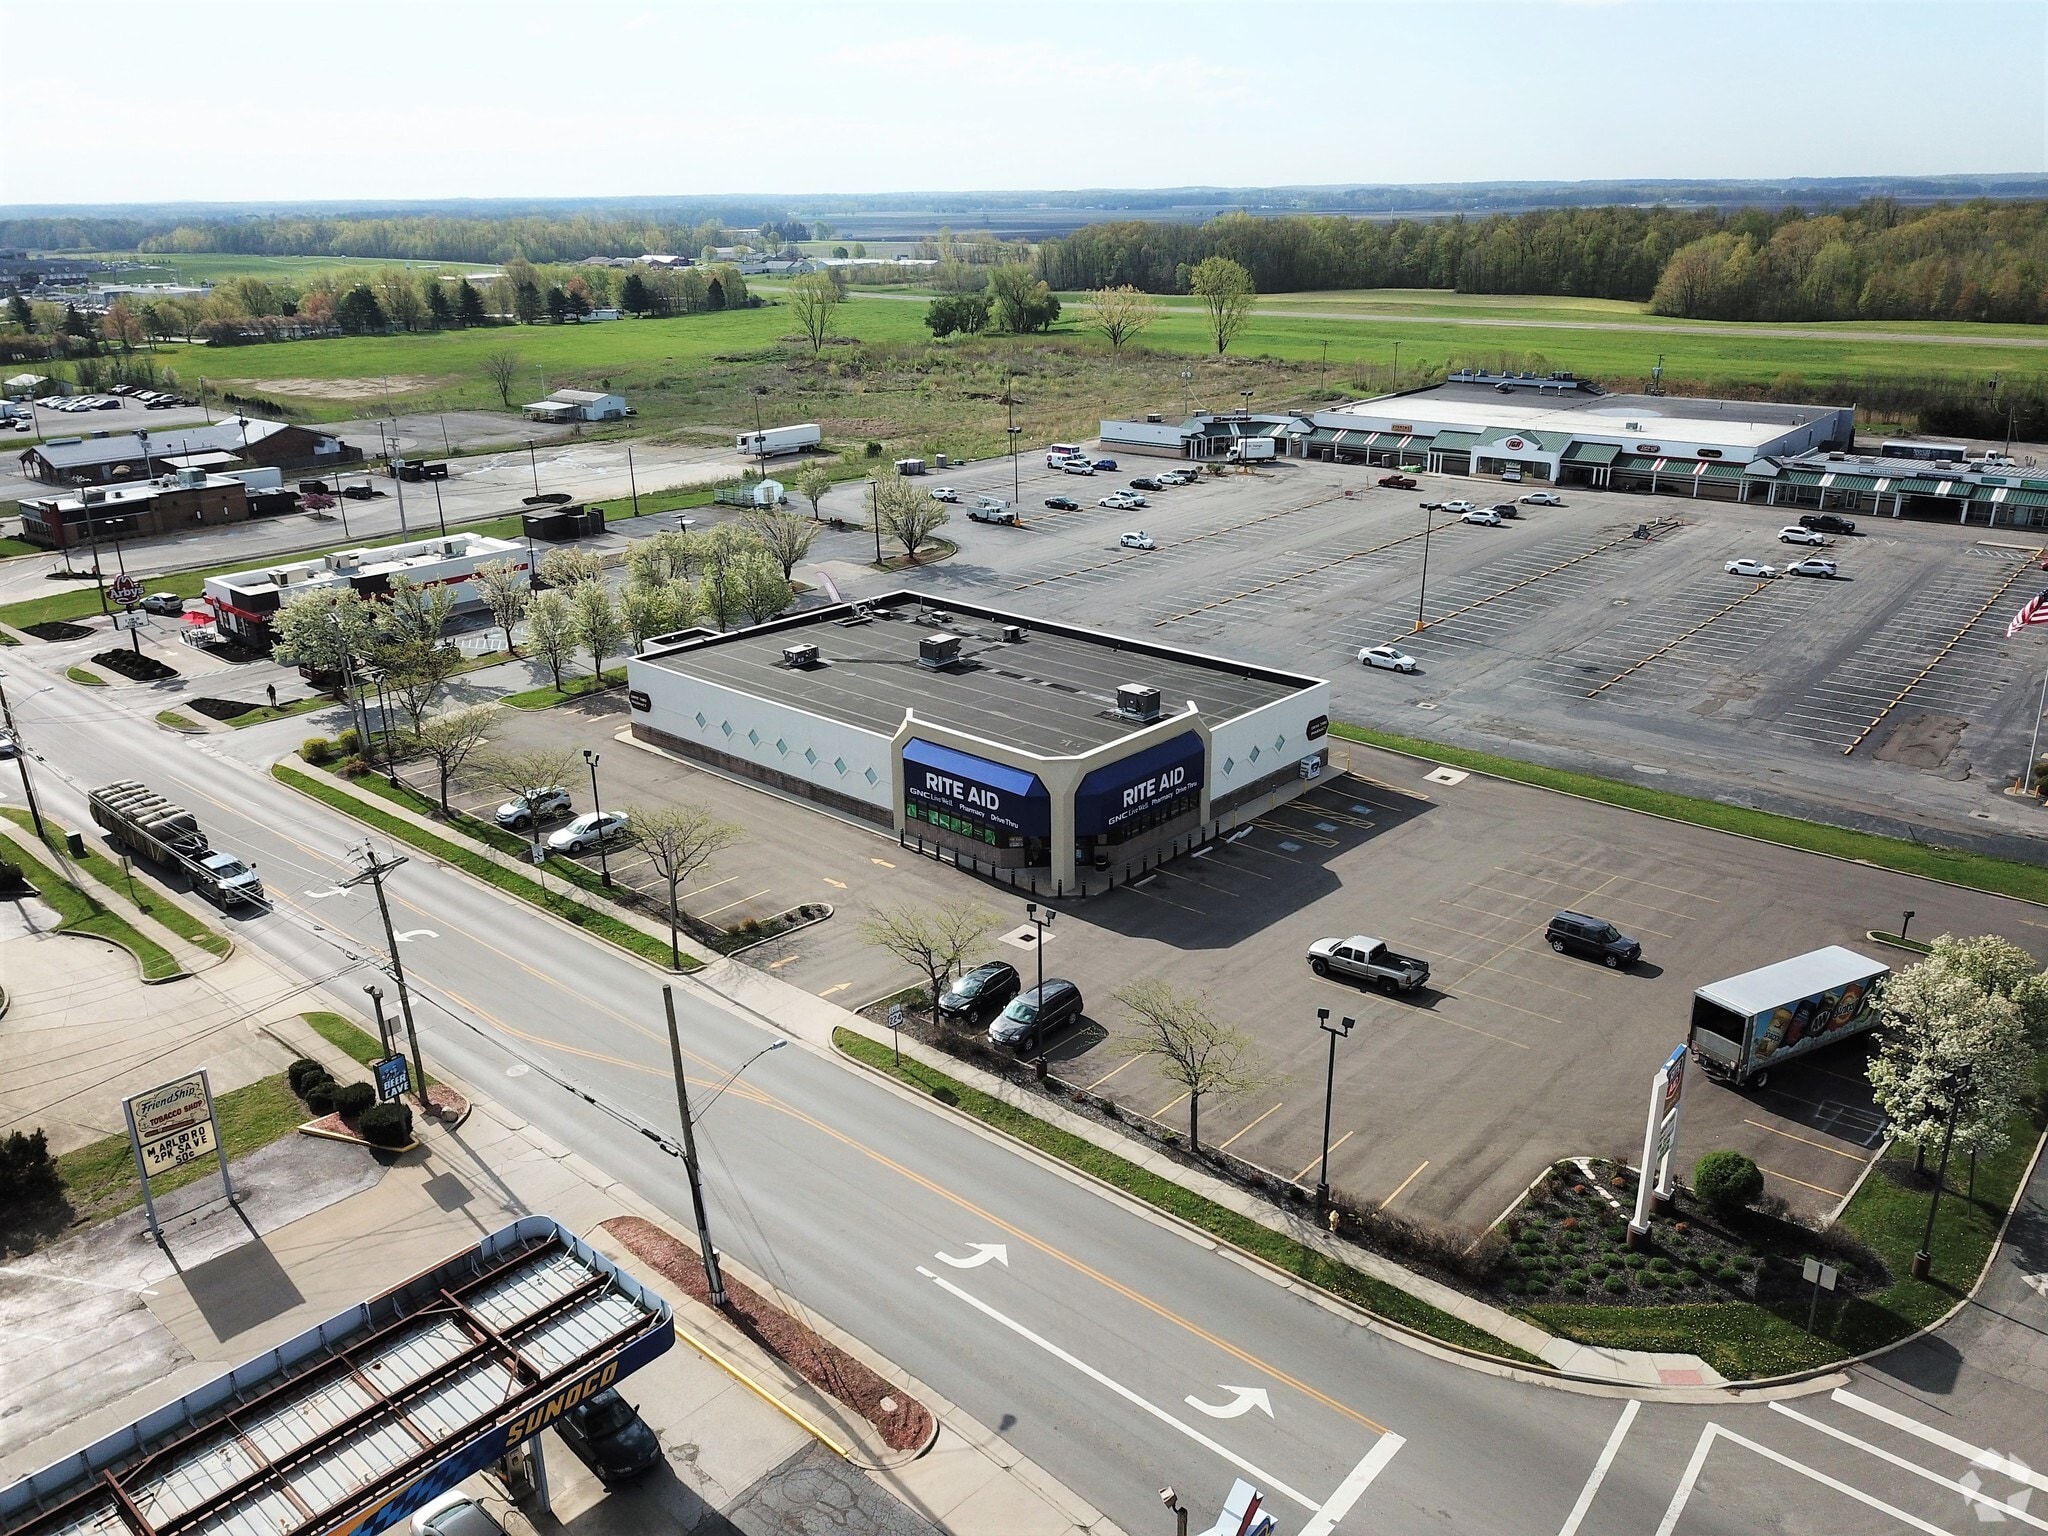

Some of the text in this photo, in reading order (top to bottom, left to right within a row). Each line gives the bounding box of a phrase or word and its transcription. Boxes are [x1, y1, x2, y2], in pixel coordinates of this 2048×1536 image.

[926, 772, 999, 811] RITE AID
[1108, 811, 1129, 825] GNC
[1151, 792, 1174, 806] Pharmacy
[1175, 787, 1187, 795] Drive
[1187, 781, 1198, 790] Thru
[1123, 766, 1185, 808] RITE AID
[909, 787, 931, 799] GNC
[959, 803, 986, 818] Pharmacy
[990, 813, 1005, 825] Drive
[1005, 817, 1019, 829] Thru
[383, 1073, 407, 1090] BEER
[385, 1081, 409, 1099] CAVE
[141, 1086, 195, 1114] FriendShip
[149, 1100, 203, 1127] TOBACCO SHOP
[154, 1135, 207, 1164] 2PK SAVE
[505, 1360, 619, 1447] SUNOCO
